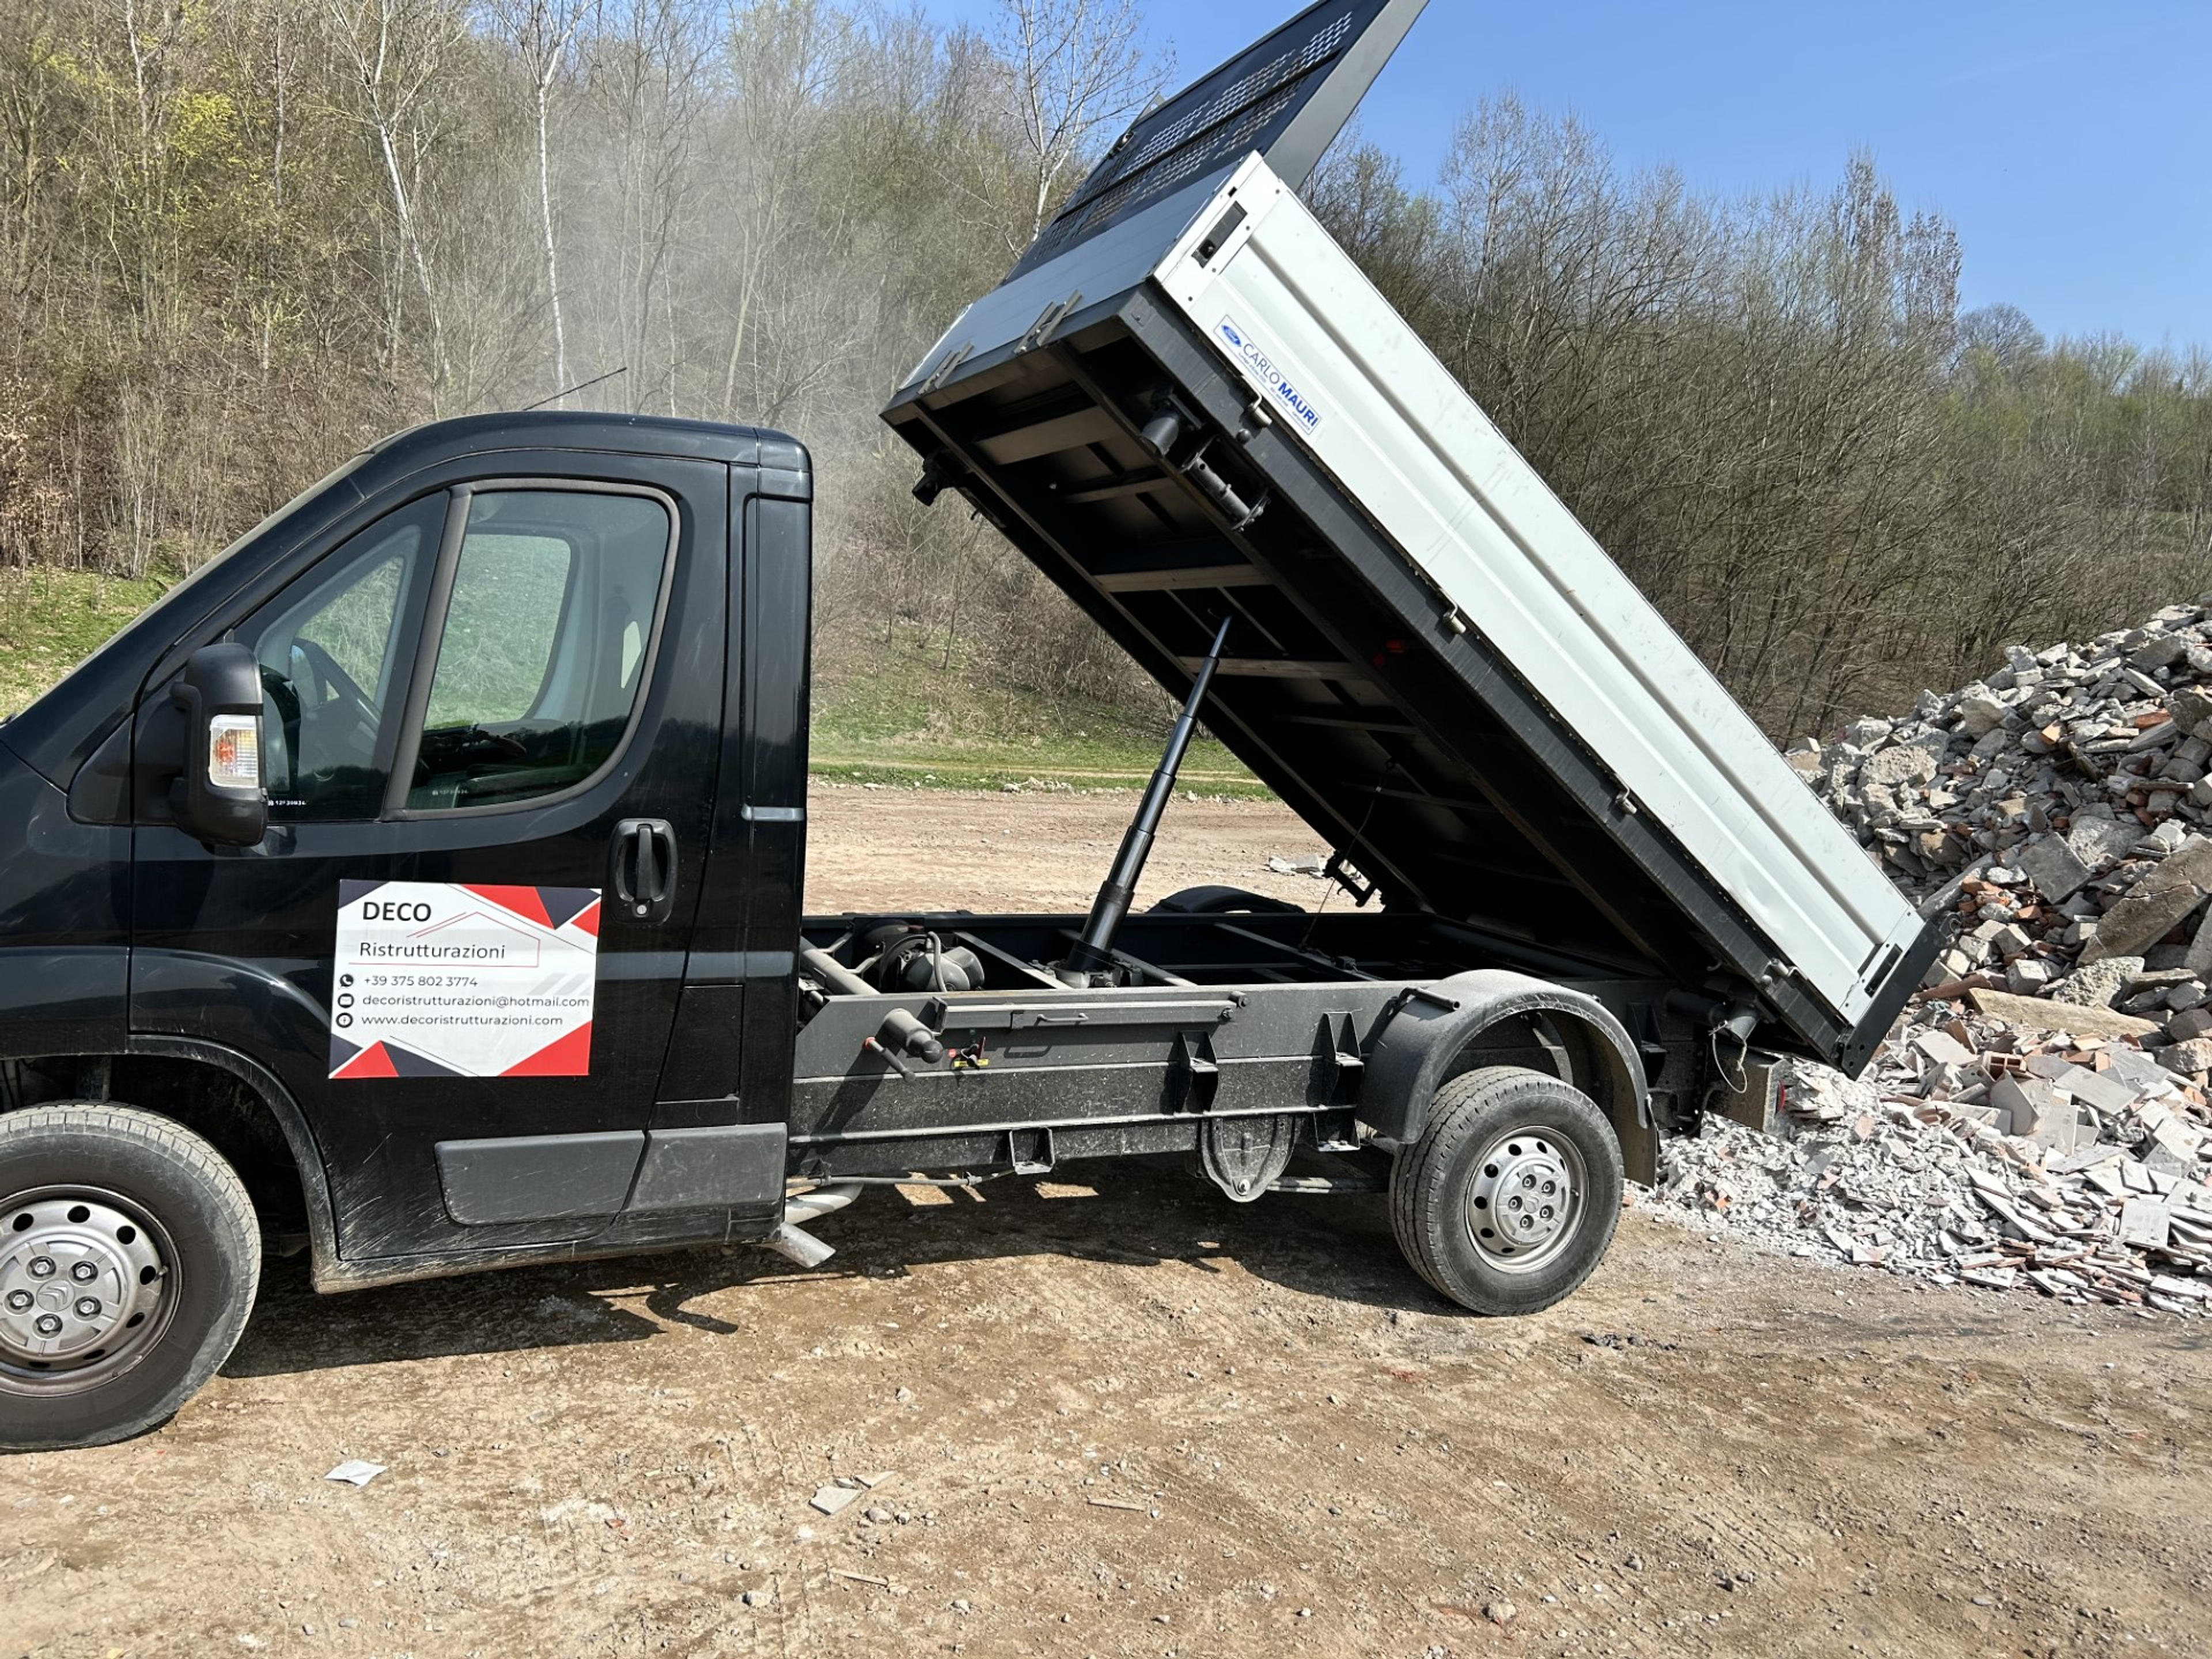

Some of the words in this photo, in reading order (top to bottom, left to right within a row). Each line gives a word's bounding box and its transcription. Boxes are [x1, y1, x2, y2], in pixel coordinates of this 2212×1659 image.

[1243, 343, 1280, 385] CARLO
[1278, 382, 1319, 427] MAURI
[363, 902, 431, 922] DECO
[360, 942, 505, 959] Ristrutturazioni
[364, 976, 387, 986] +39
[391, 976, 414, 986] 375
[418, 976, 442, 987] 802
[446, 976, 478, 987] 3774
[362, 995, 590, 1008] decoristrutturazioni@hotmail.com
[361, 1014, 563, 1025] www.decoristrutturazioni.com
